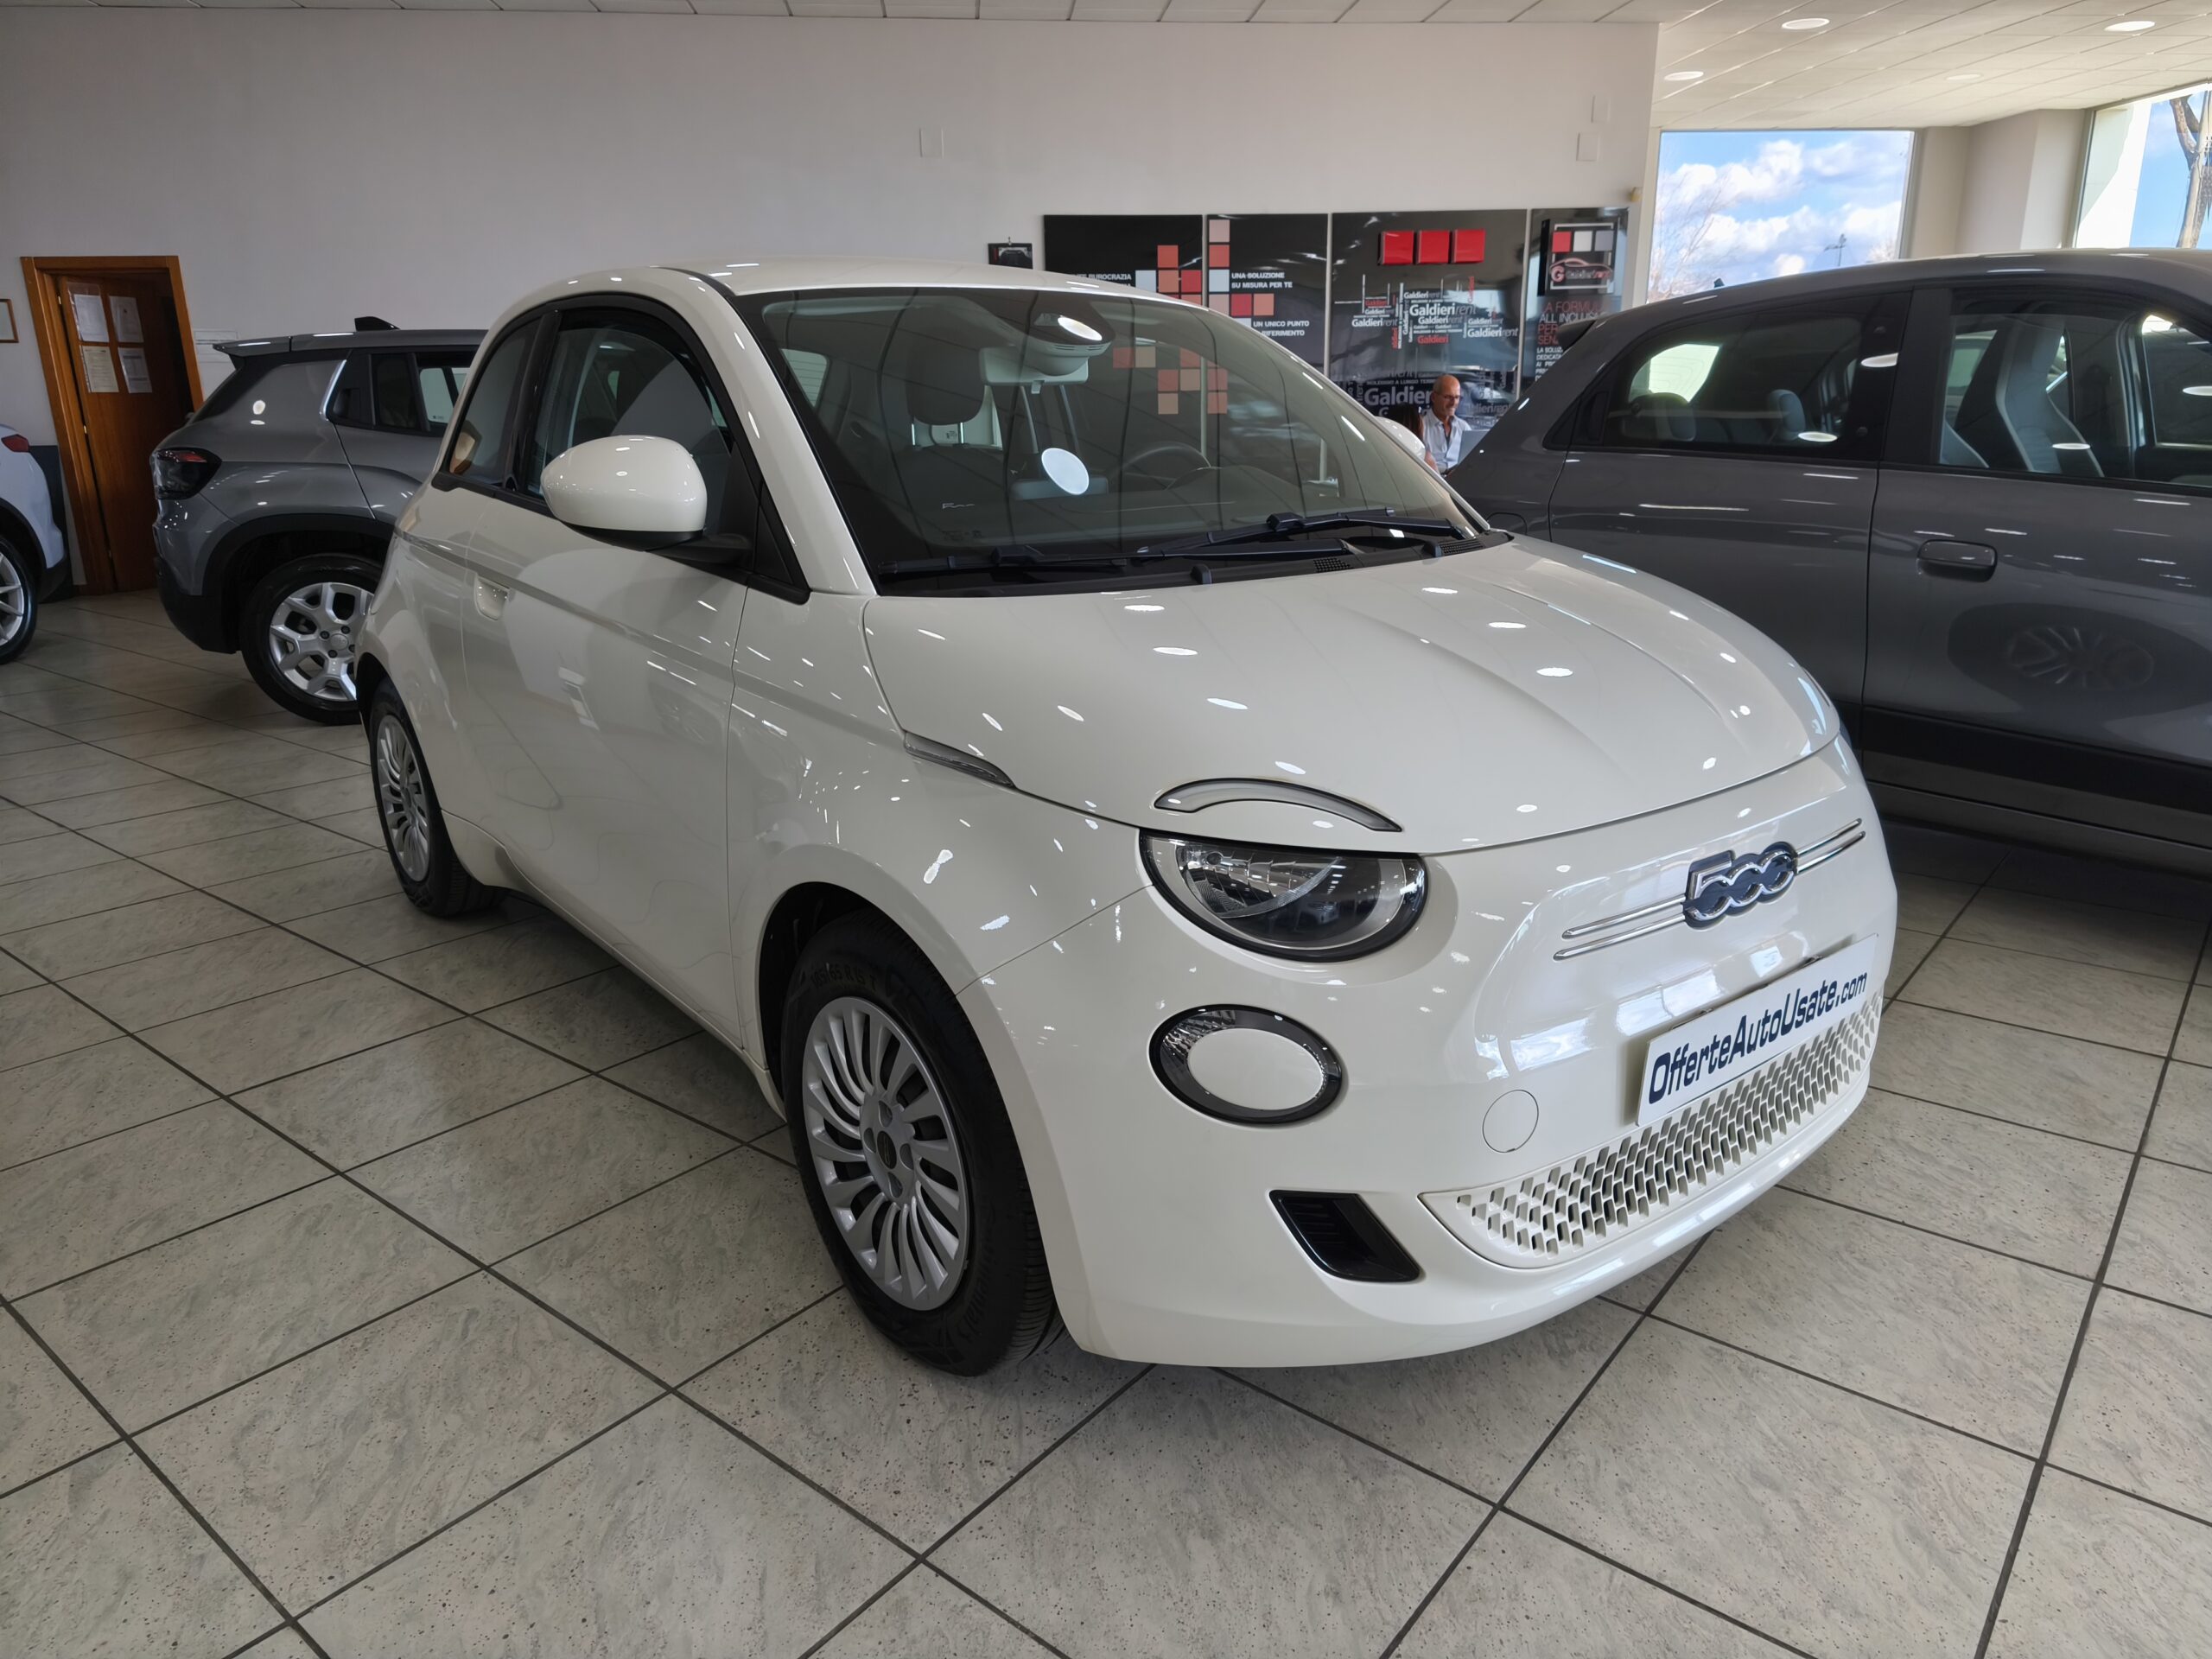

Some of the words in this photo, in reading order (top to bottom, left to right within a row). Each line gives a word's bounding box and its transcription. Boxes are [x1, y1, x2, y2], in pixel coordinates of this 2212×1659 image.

[1409, 302, 1476, 316] Galdierirent
[1364, 385, 1433, 406] Galdier
[1683, 842, 1799, 931] 500
[1648, 971, 1868, 1104] OfferteAutoUsate.com
